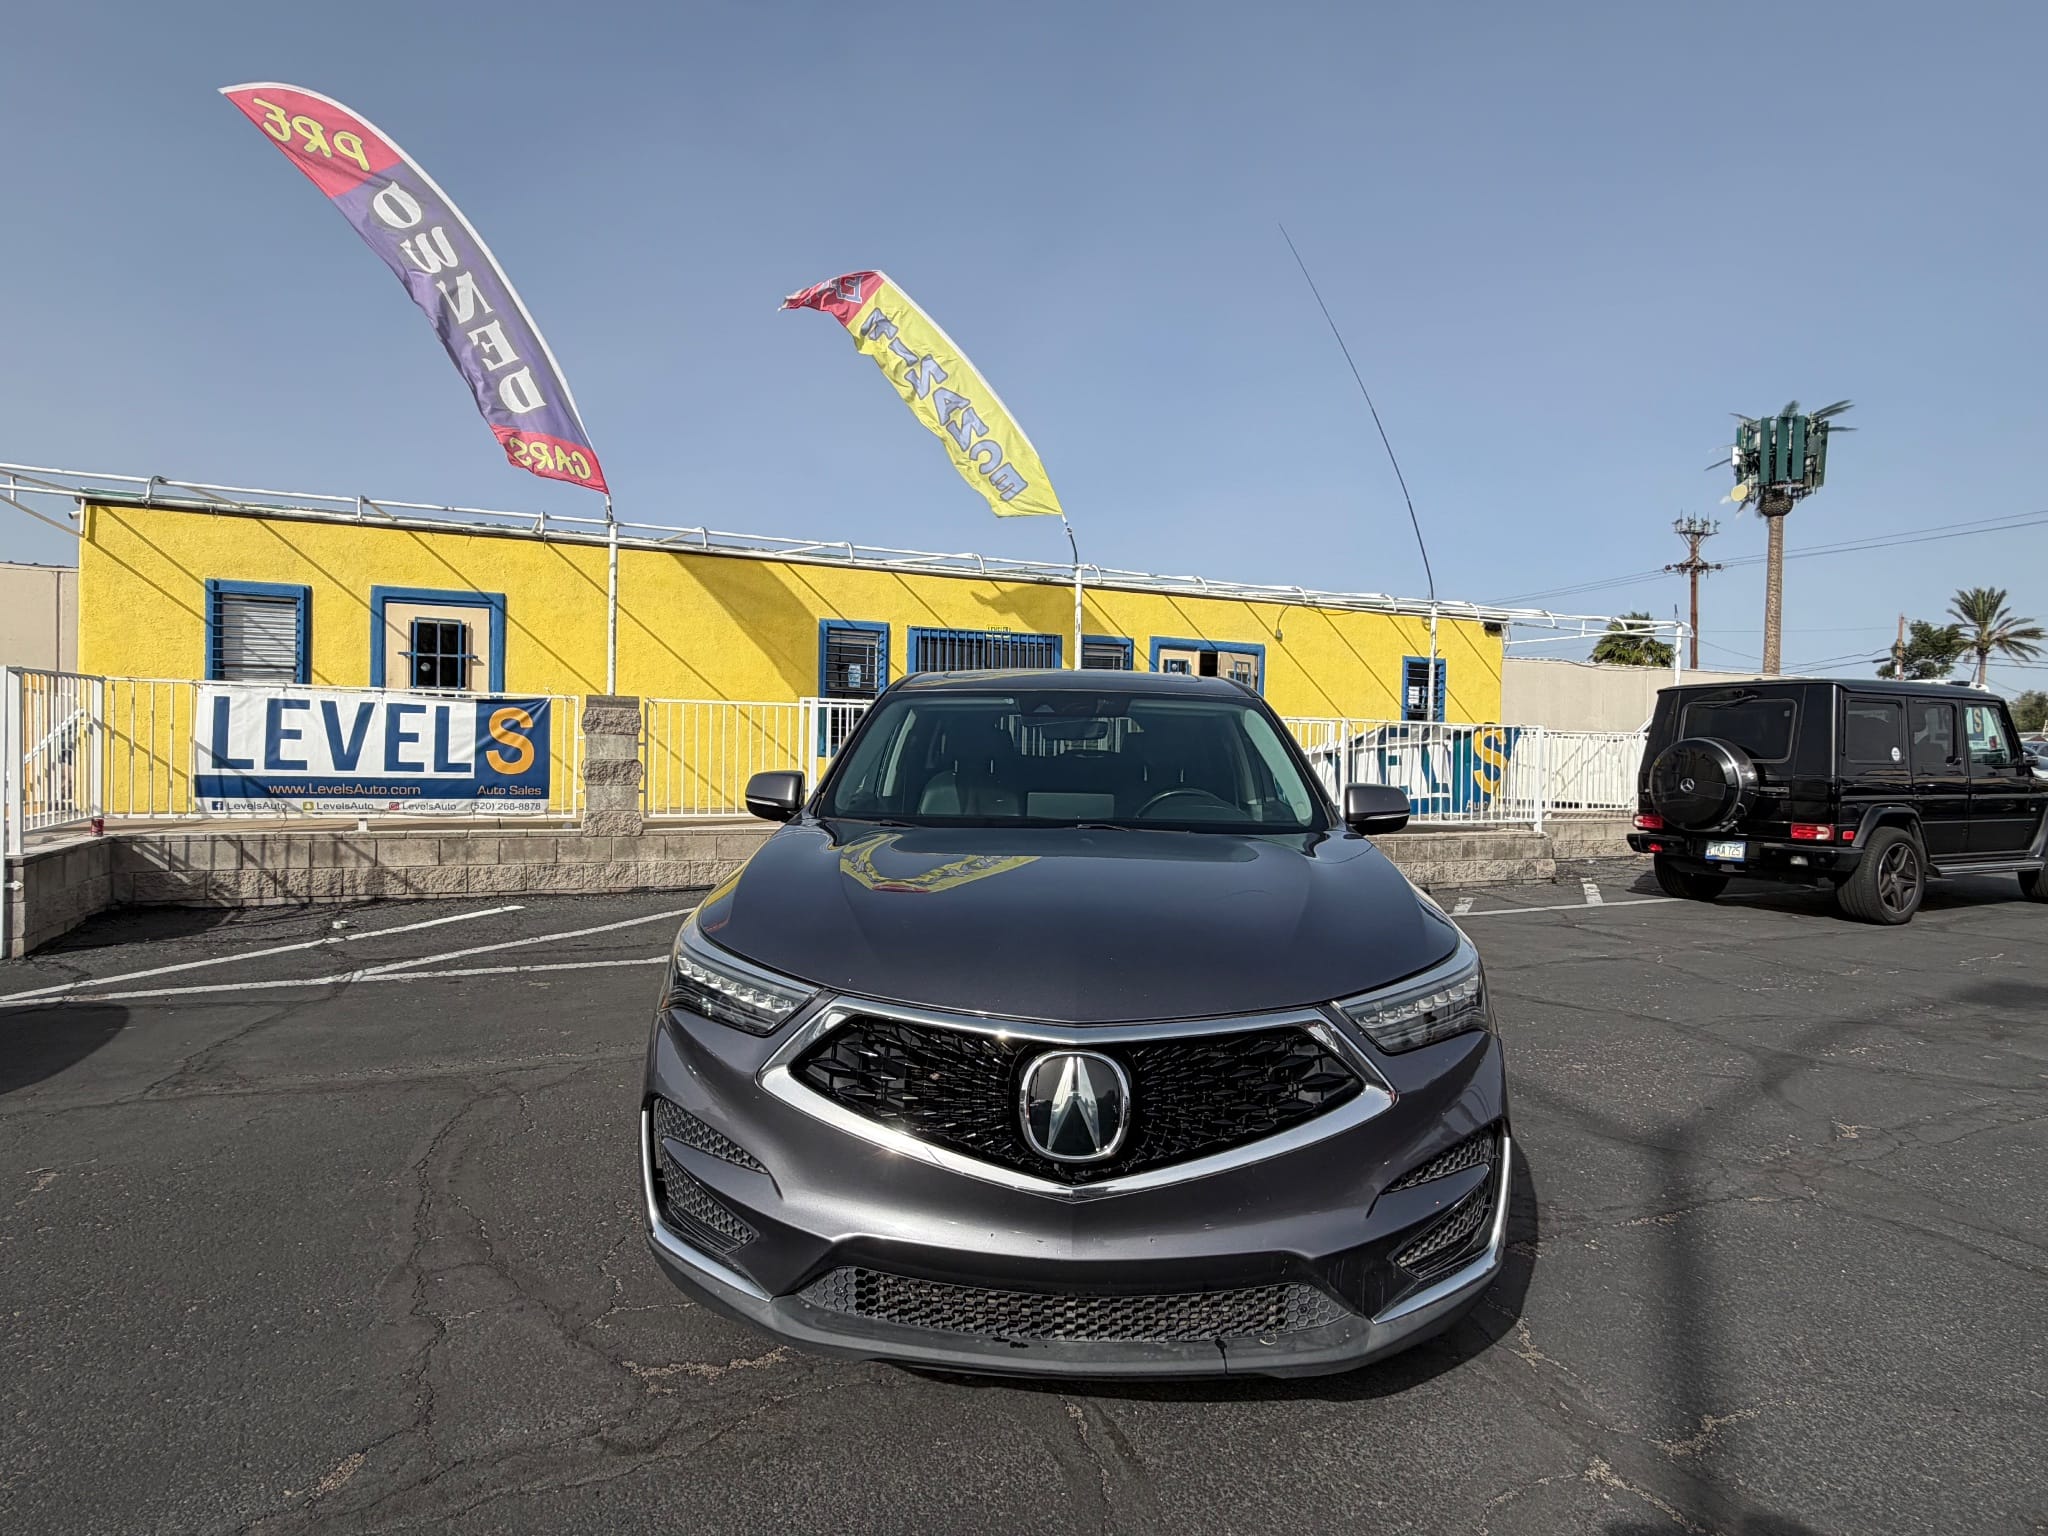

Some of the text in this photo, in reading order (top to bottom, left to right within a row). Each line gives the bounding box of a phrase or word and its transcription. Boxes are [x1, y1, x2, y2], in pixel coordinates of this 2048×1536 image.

[268, 782, 421, 796] www.LevelsAuto.com
[476, 785, 542, 796] Auto Sales
[316, 801, 374, 811] LevelsAuto
[402, 801, 457, 811] LevelsAuto
